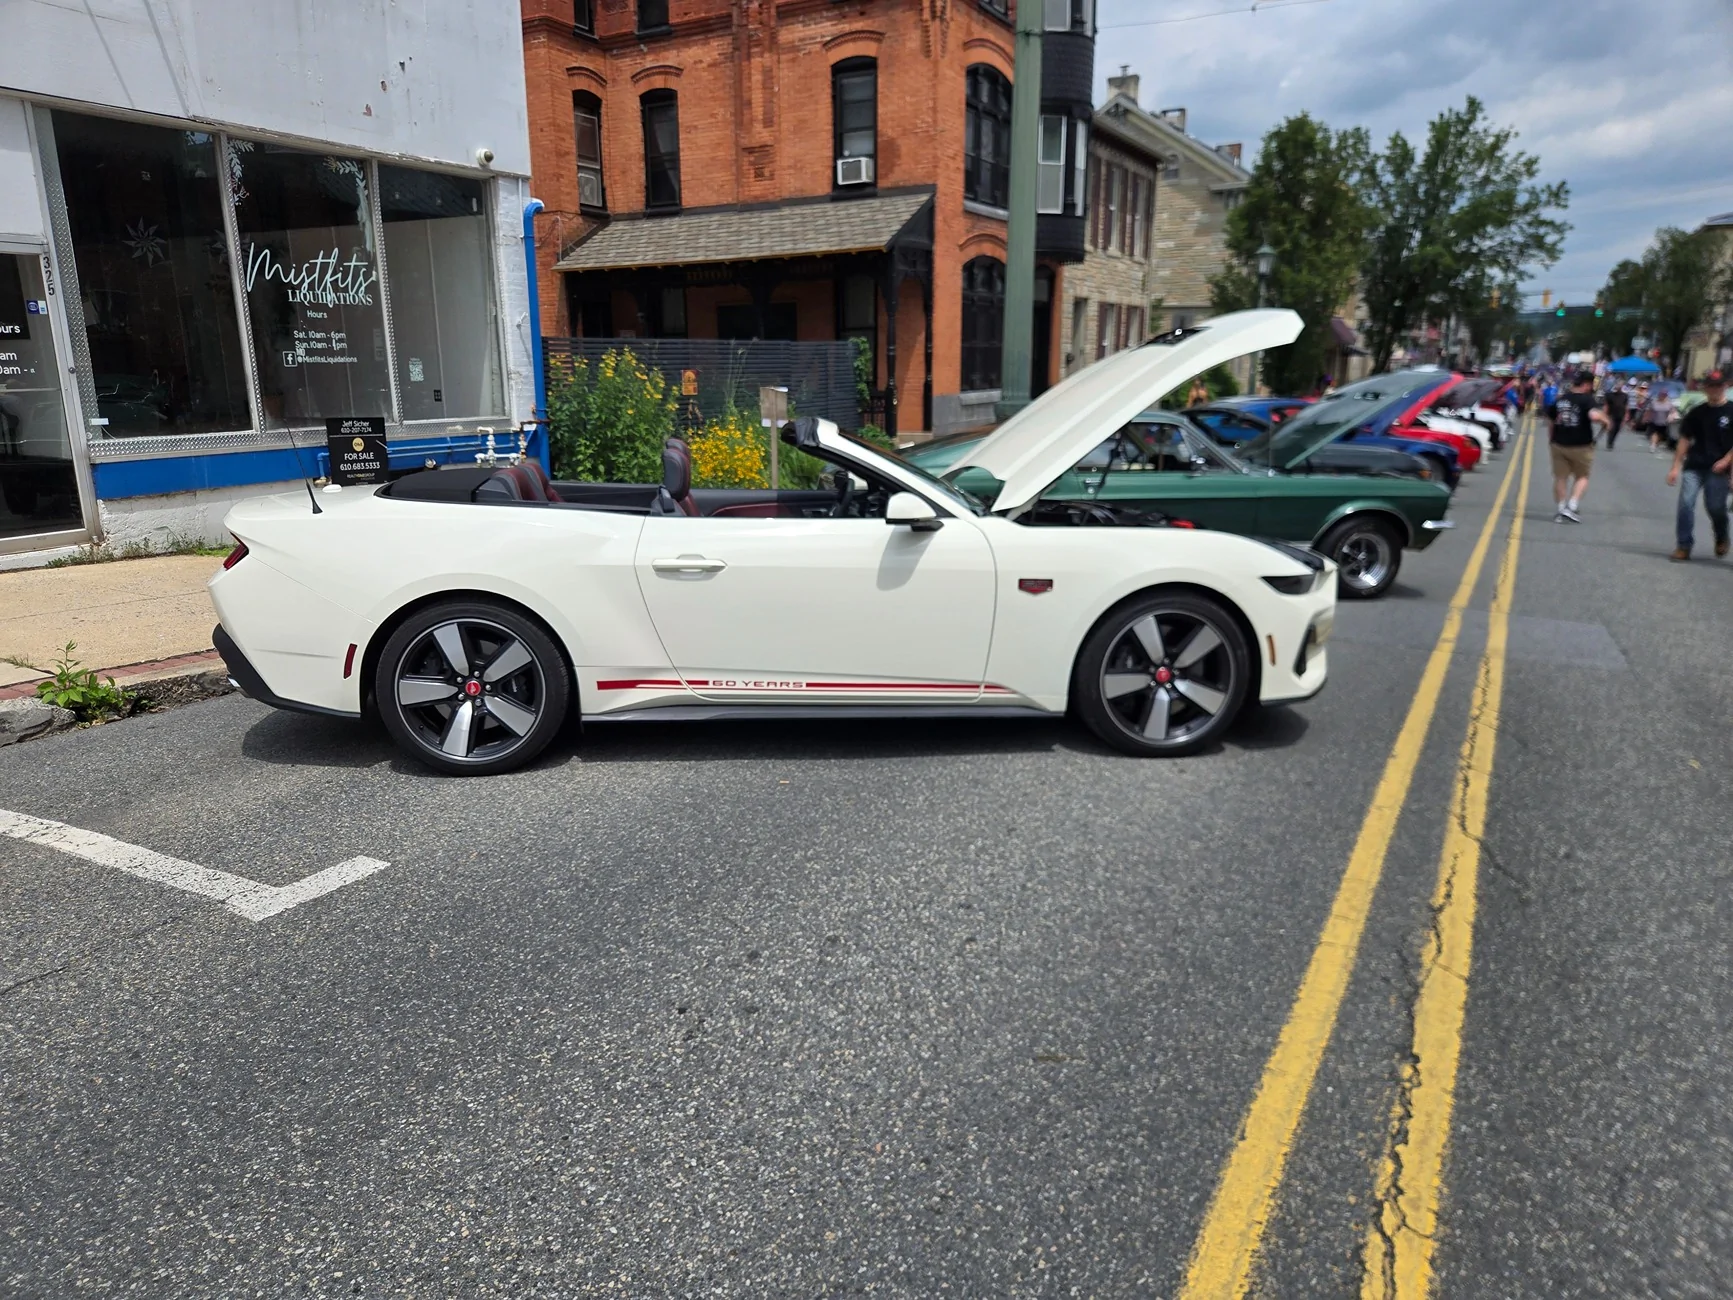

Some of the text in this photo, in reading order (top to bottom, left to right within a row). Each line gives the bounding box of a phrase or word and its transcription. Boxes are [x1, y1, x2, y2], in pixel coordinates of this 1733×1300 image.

[43, 256, 55, 296] 325
[246, 242, 375, 308] Mistfits
[287, 289, 373, 306] LIQUIDATIONS
[306, 310, 328, 318] Hours
[293, 330, 307, 339] Sat.
[308, 330, 326, 339] 10am
[331, 331, 347, 340] 6pm
[358, 452, 375, 460] SALE
[340, 461, 381, 471] 610.683.5333
[742, 680, 803, 688] YEARS
